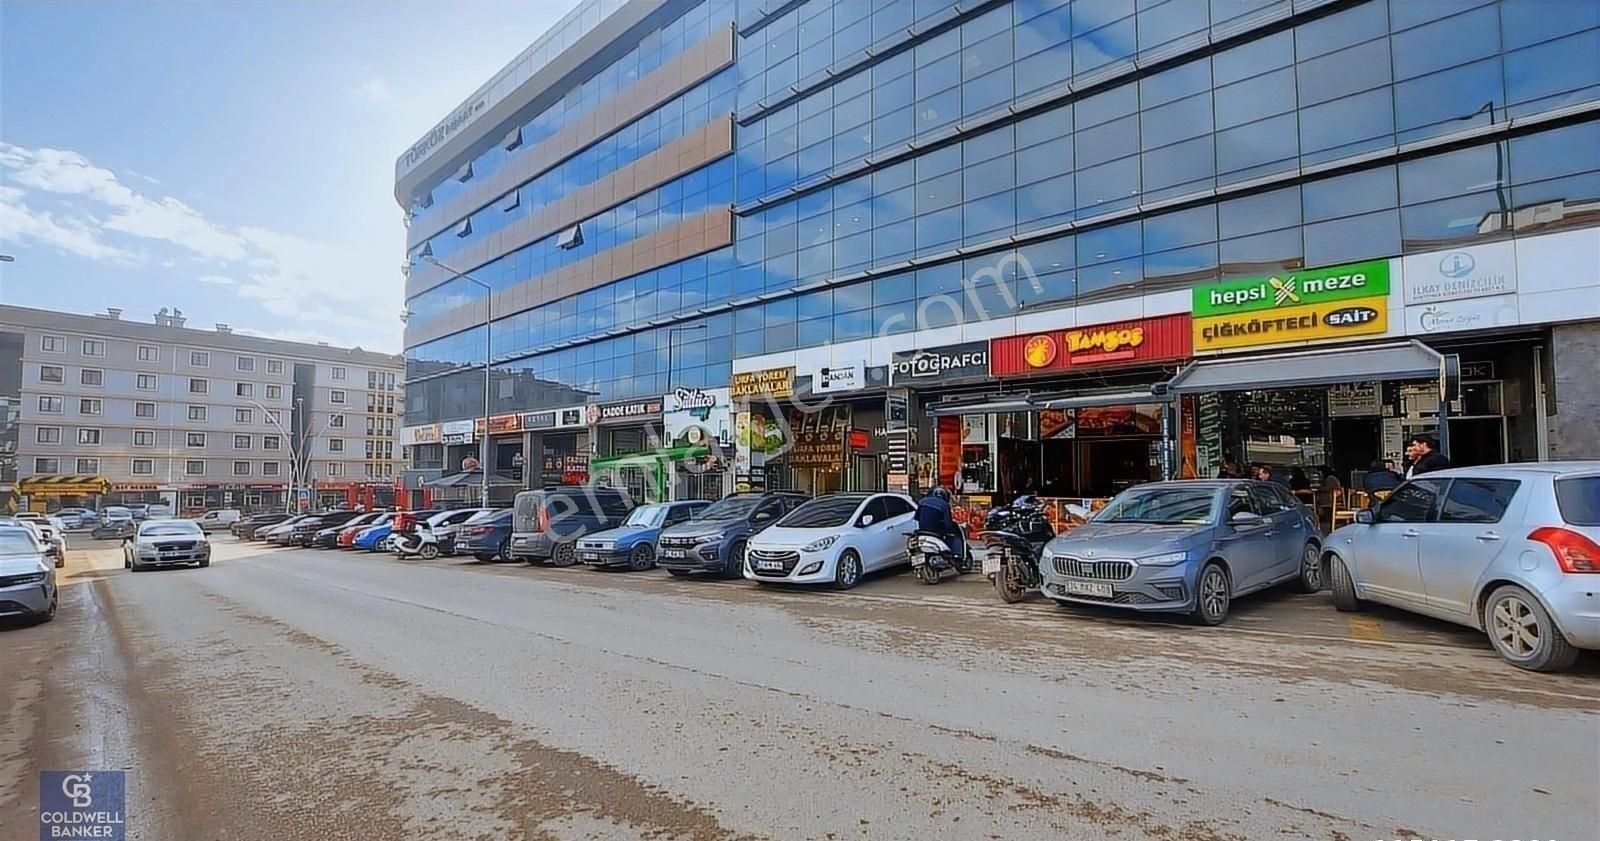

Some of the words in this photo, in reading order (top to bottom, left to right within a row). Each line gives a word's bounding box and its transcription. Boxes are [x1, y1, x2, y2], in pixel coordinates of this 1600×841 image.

[1211, 284, 1266, 305] hepsi
[1303, 273, 1366, 293] meze
[1202, 312, 1318, 342] ÇİĞKÖFTECİ
[1328, 309, 1371, 325] SAİT
